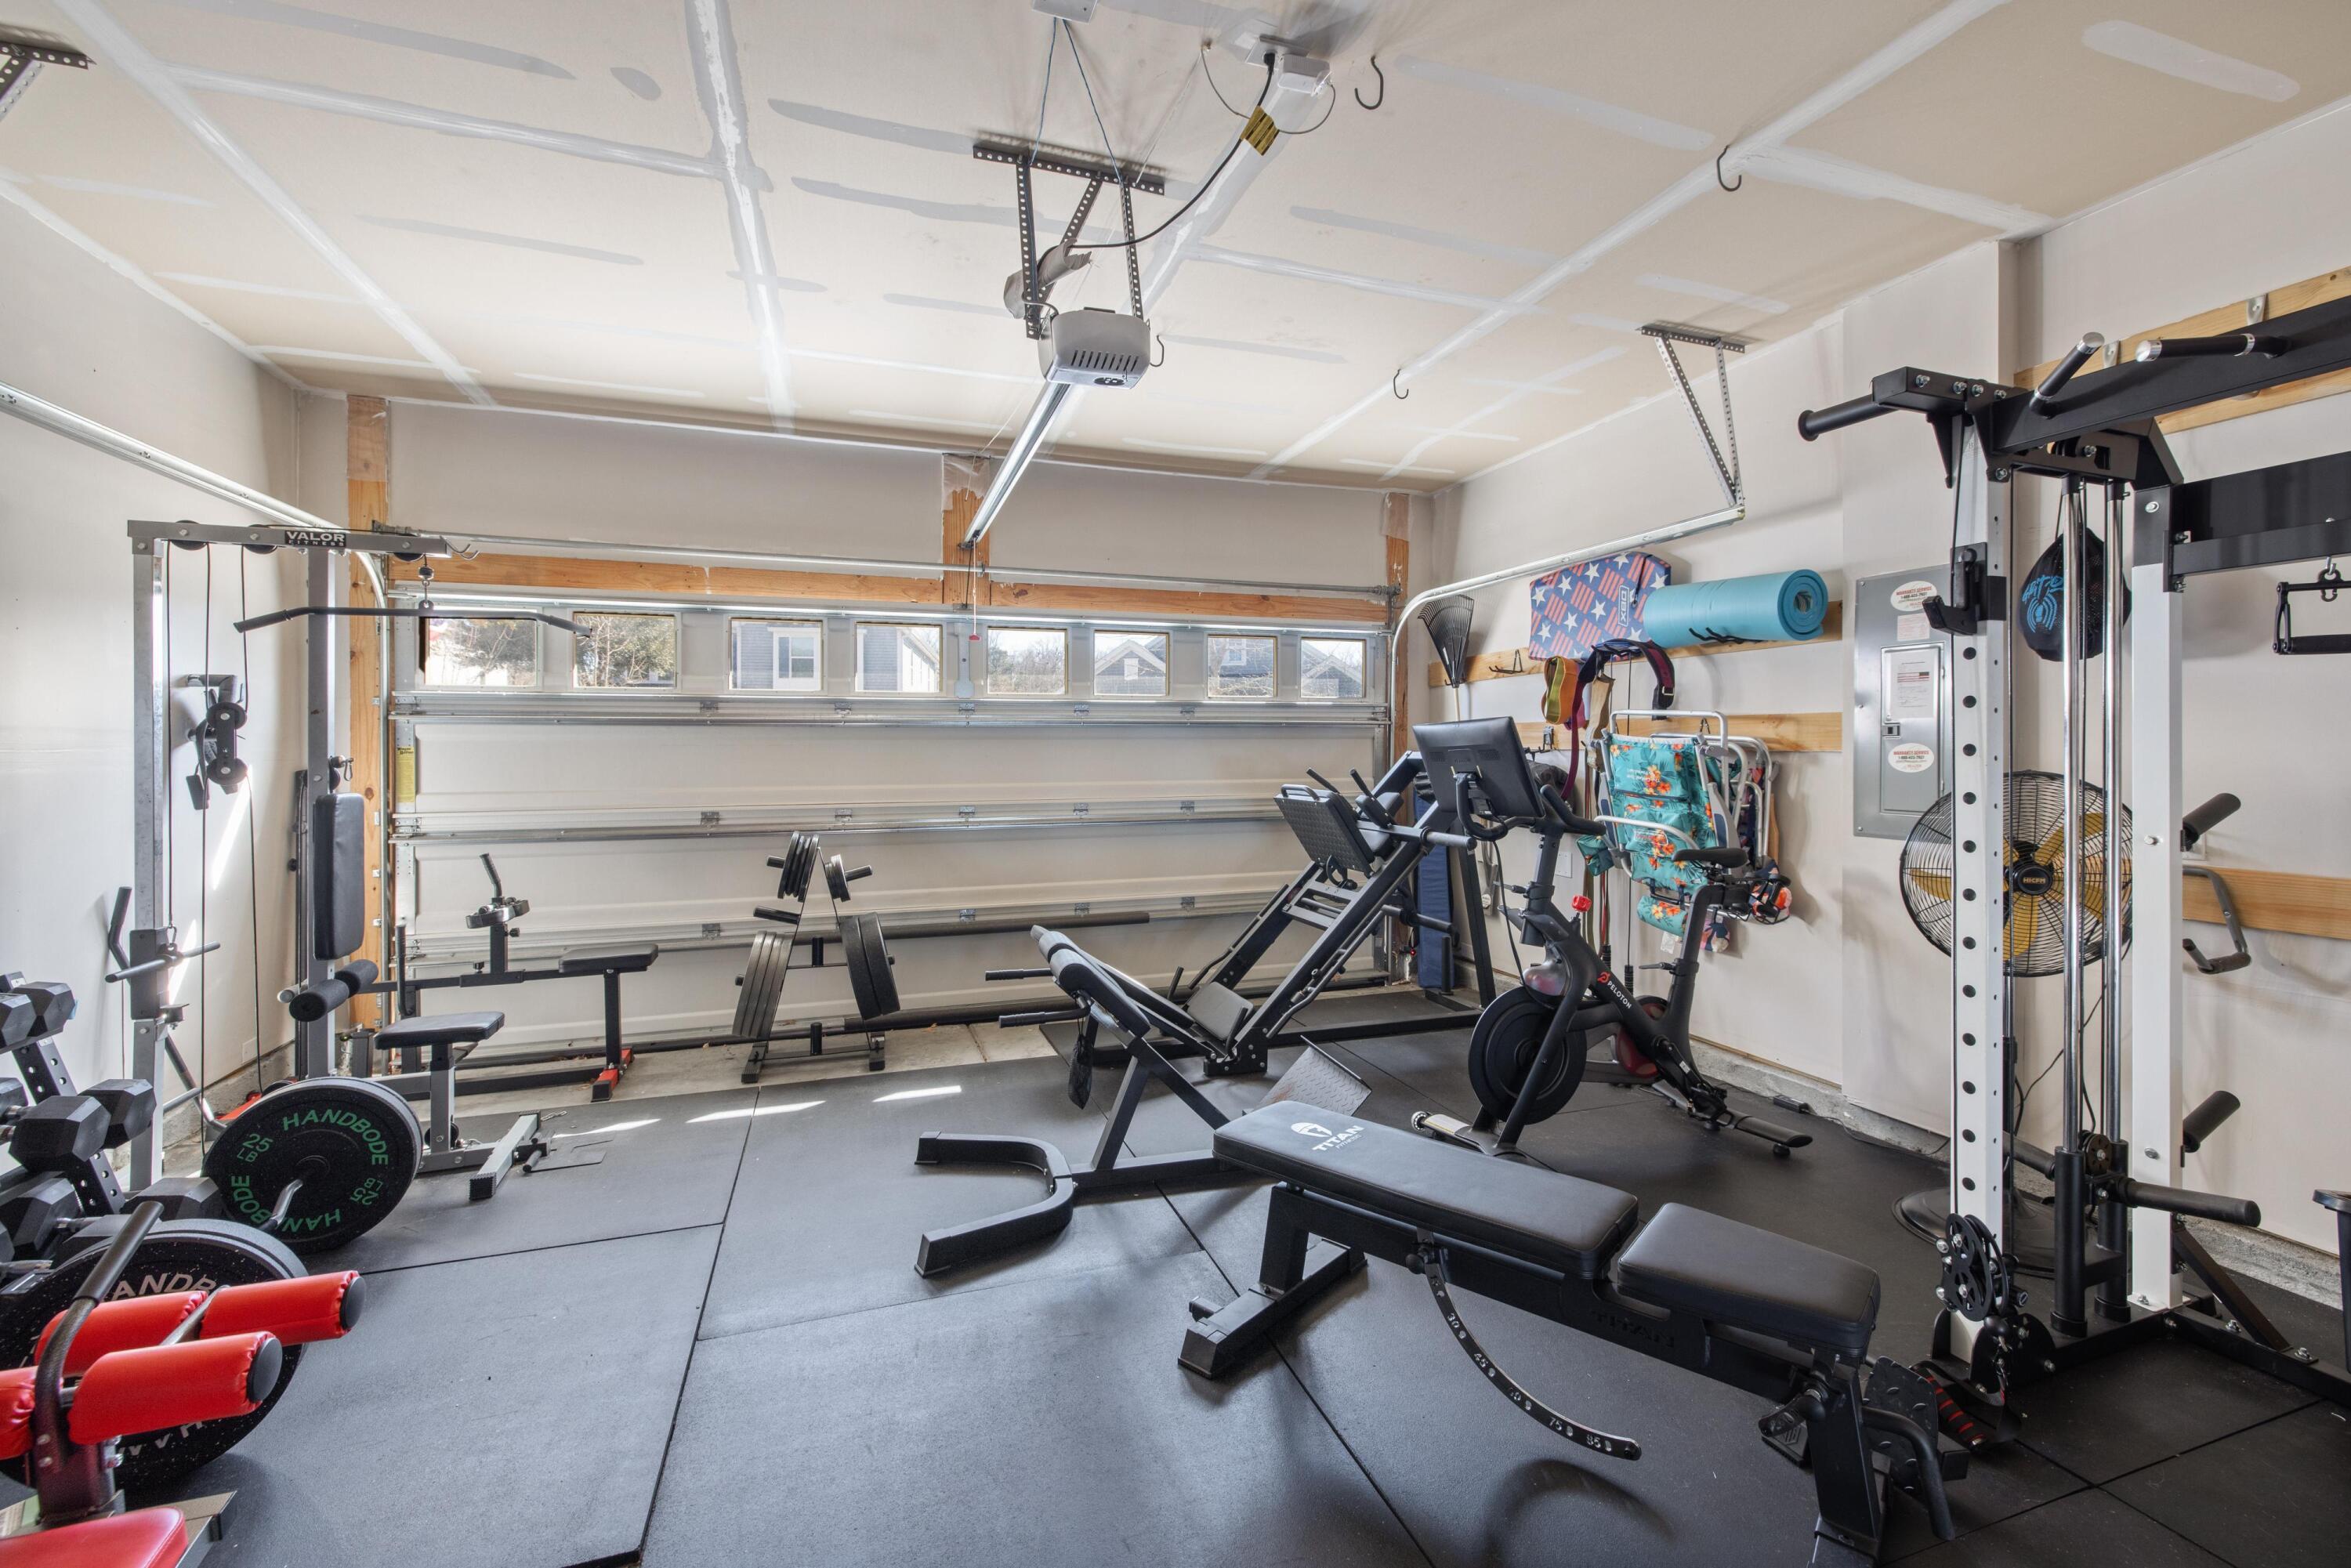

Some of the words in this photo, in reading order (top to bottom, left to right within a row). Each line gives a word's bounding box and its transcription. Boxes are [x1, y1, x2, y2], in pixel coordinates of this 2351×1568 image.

[286, 531, 345, 541] VALOR
[1607, 980, 1632, 1009] PELOTON
[242, 1134, 273, 1153] 25
[283, 1109, 389, 1166] HANDBODE
[1312, 1125, 1365, 1151] TITAN
[237, 1148, 259, 1163] LB
[364, 1177, 383, 1191] LB
[231, 1175, 342, 1233] HANBODE
[350, 1186, 379, 1206] 25
[1447, 1313, 1460, 1328] 30
[1473, 1353, 1488, 1367] 45
[1549, 1417, 1563, 1431] 75
